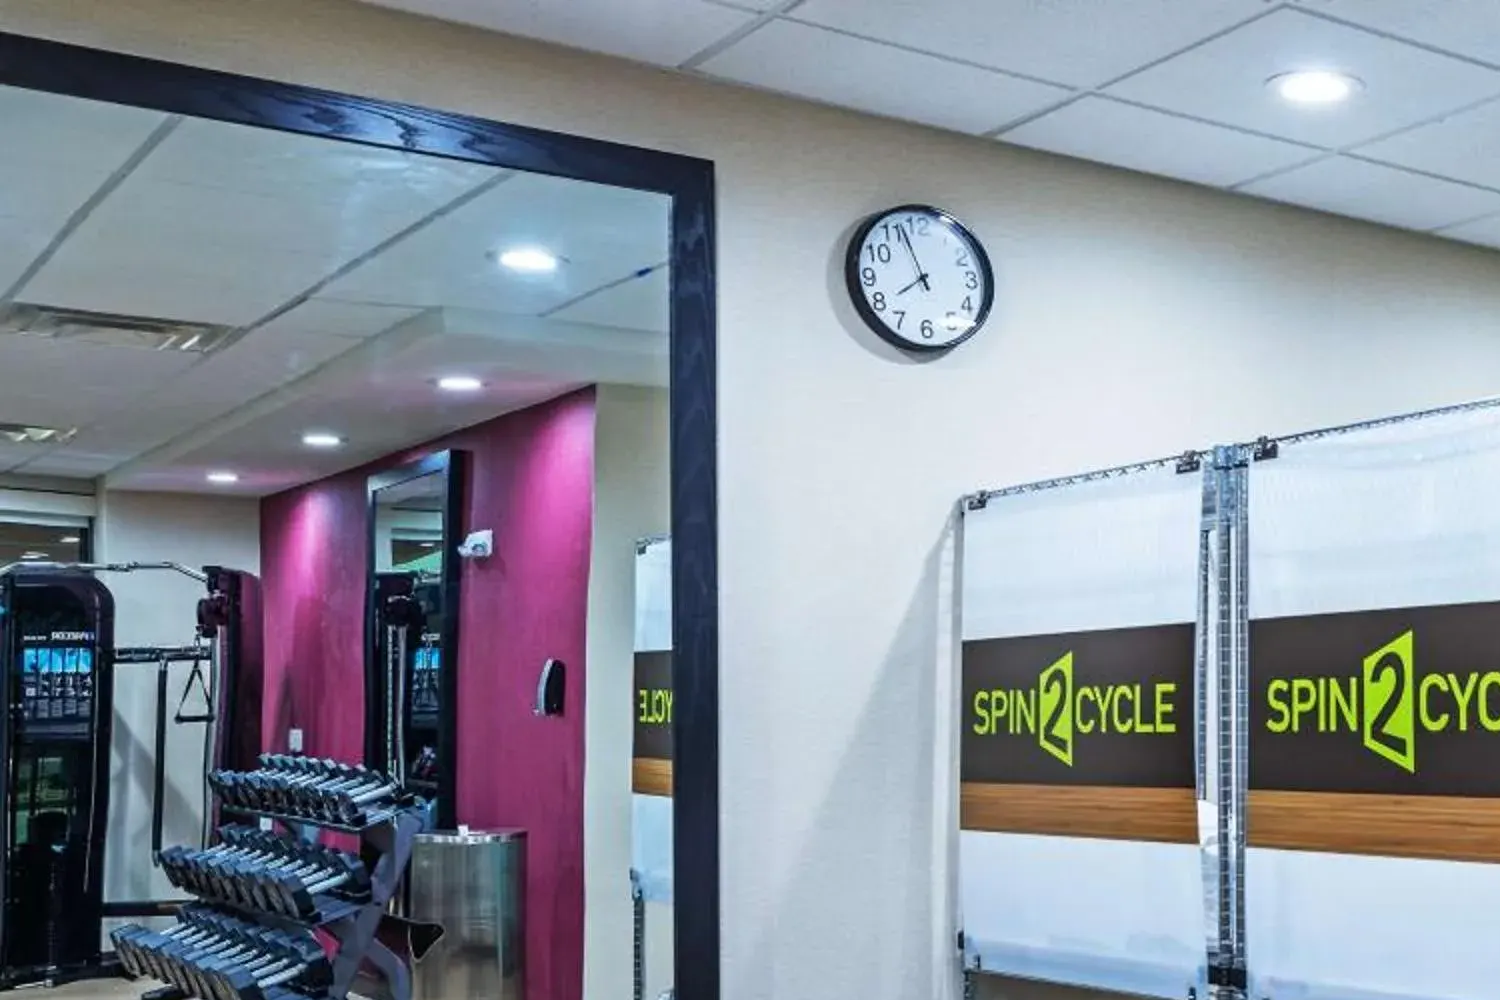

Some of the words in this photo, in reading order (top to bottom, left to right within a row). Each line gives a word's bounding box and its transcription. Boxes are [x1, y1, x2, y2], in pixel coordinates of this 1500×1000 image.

[880, 224, 902, 242] 11
[906, 216, 930, 236] 12
[867, 243, 891, 263] 10
[956, 248, 968, 267] 2
[862, 267, 876, 287] 9
[965, 271, 978, 290] 3
[872, 291, 887, 311] 8
[961, 296, 973, 313] 4
[893, 311, 906, 330] 7
[920, 320, 934, 339] 6
